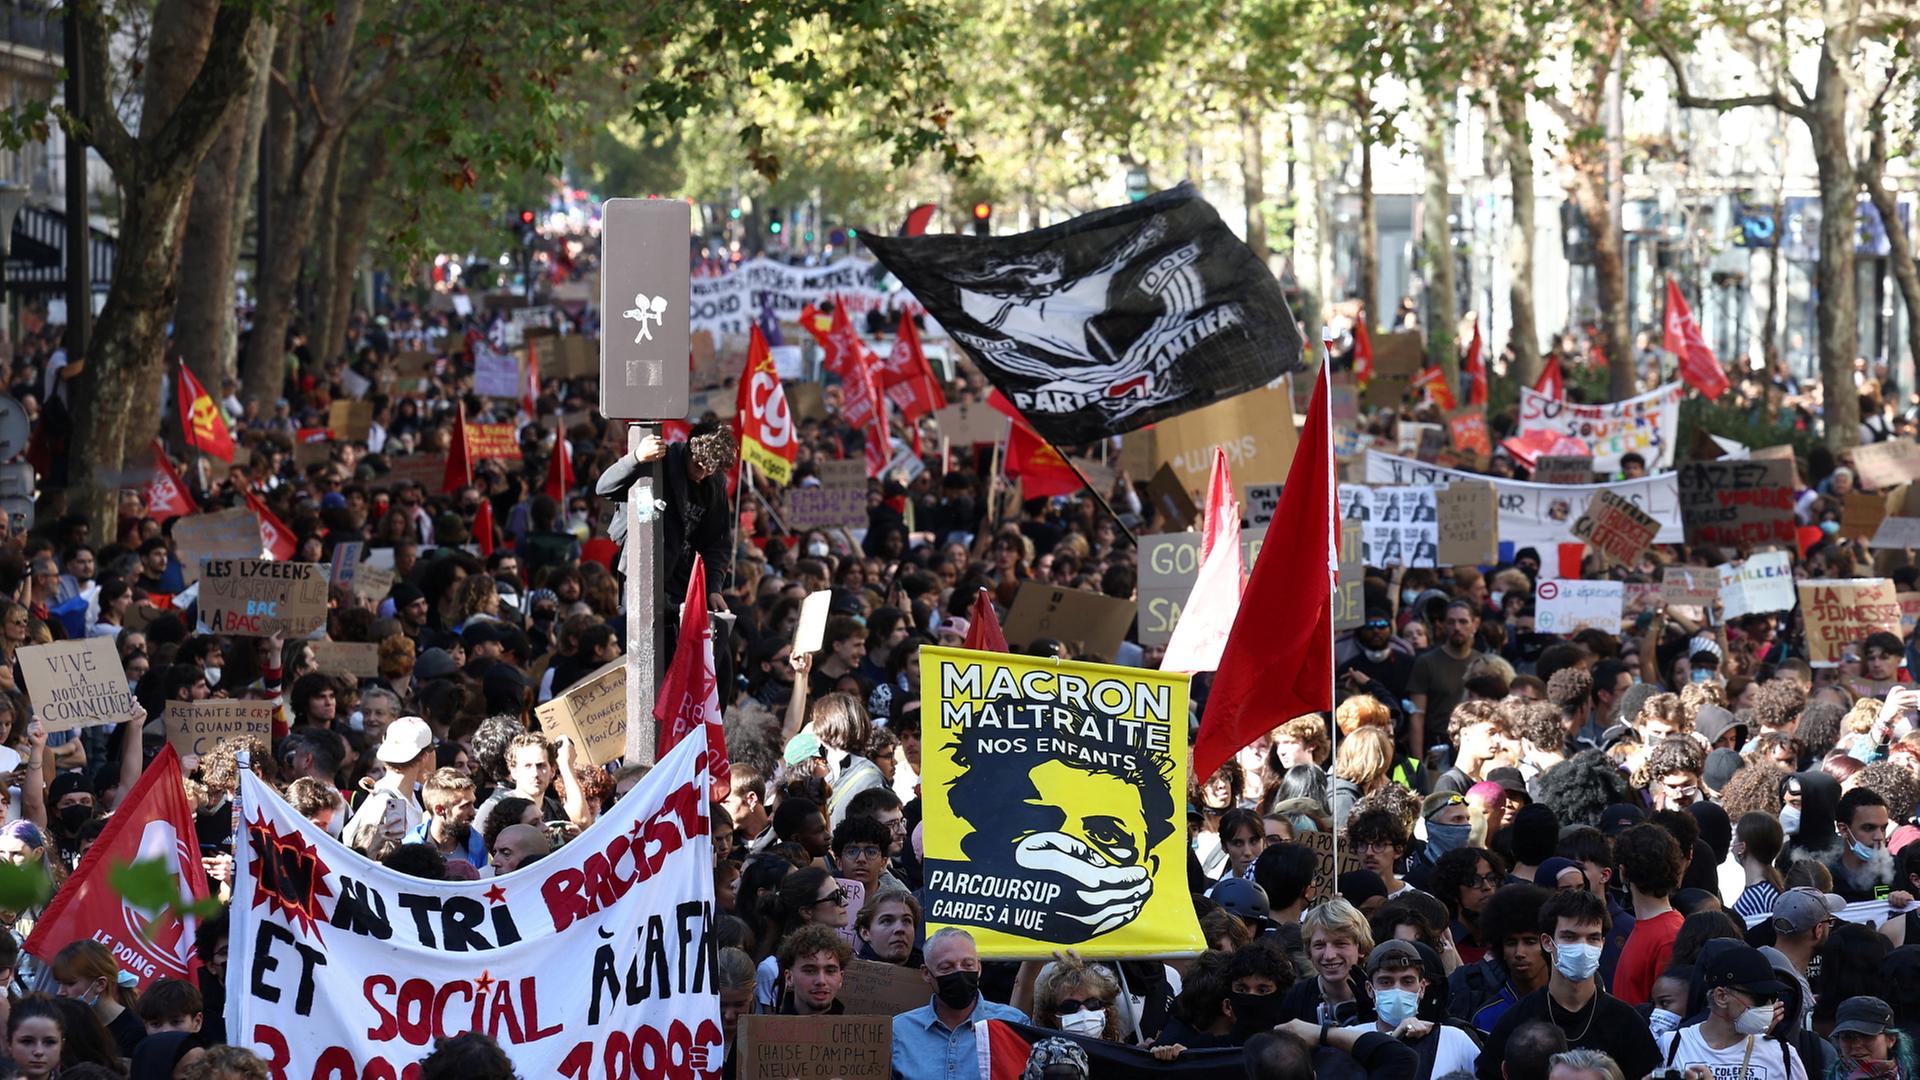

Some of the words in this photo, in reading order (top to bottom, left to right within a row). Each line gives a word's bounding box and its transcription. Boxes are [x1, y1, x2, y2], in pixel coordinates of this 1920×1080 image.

[1155, 303, 1240, 376] ANTIFA
[206, 561, 233, 578] LES
[1814, 587, 1840, 604] LA
[246, 600, 278, 618] BAC
[224, 611, 262, 633] BAC
[46, 651, 97, 673] VIVE
[68, 672, 88, 687] LA
[51, 680, 119, 702] NOUVELLE
[940, 661, 1171, 721] MACRON
[171, 706, 231, 719] RETRAITE
[235, 707, 248, 718] DE
[180, 719, 190, 734] À
[195, 721, 242, 734] QUAND
[247, 722, 270, 734] DES
[940, 700, 1171, 753] MALTRAITE
[978, 737, 1028, 754] NOS
[1036, 737, 1137, 771] ENFANTS
[928, 870, 1061, 905] PARCOURSUP
[932, 899, 995, 922] GARDES
[998, 904, 1009, 924] À
[1014, 908, 1047, 931] VUE
[92, 929, 113, 945] LE
[112, 941, 157, 978] POING
[251, 919, 327, 1017] ET
[588, 924, 621, 1026] À
[832, 1024, 885, 1044] CHERCHE
[758, 1044, 801, 1062] CHAISE
[758, 1063, 809, 1079] NEUVE
[815, 1064, 834, 1075] OU
